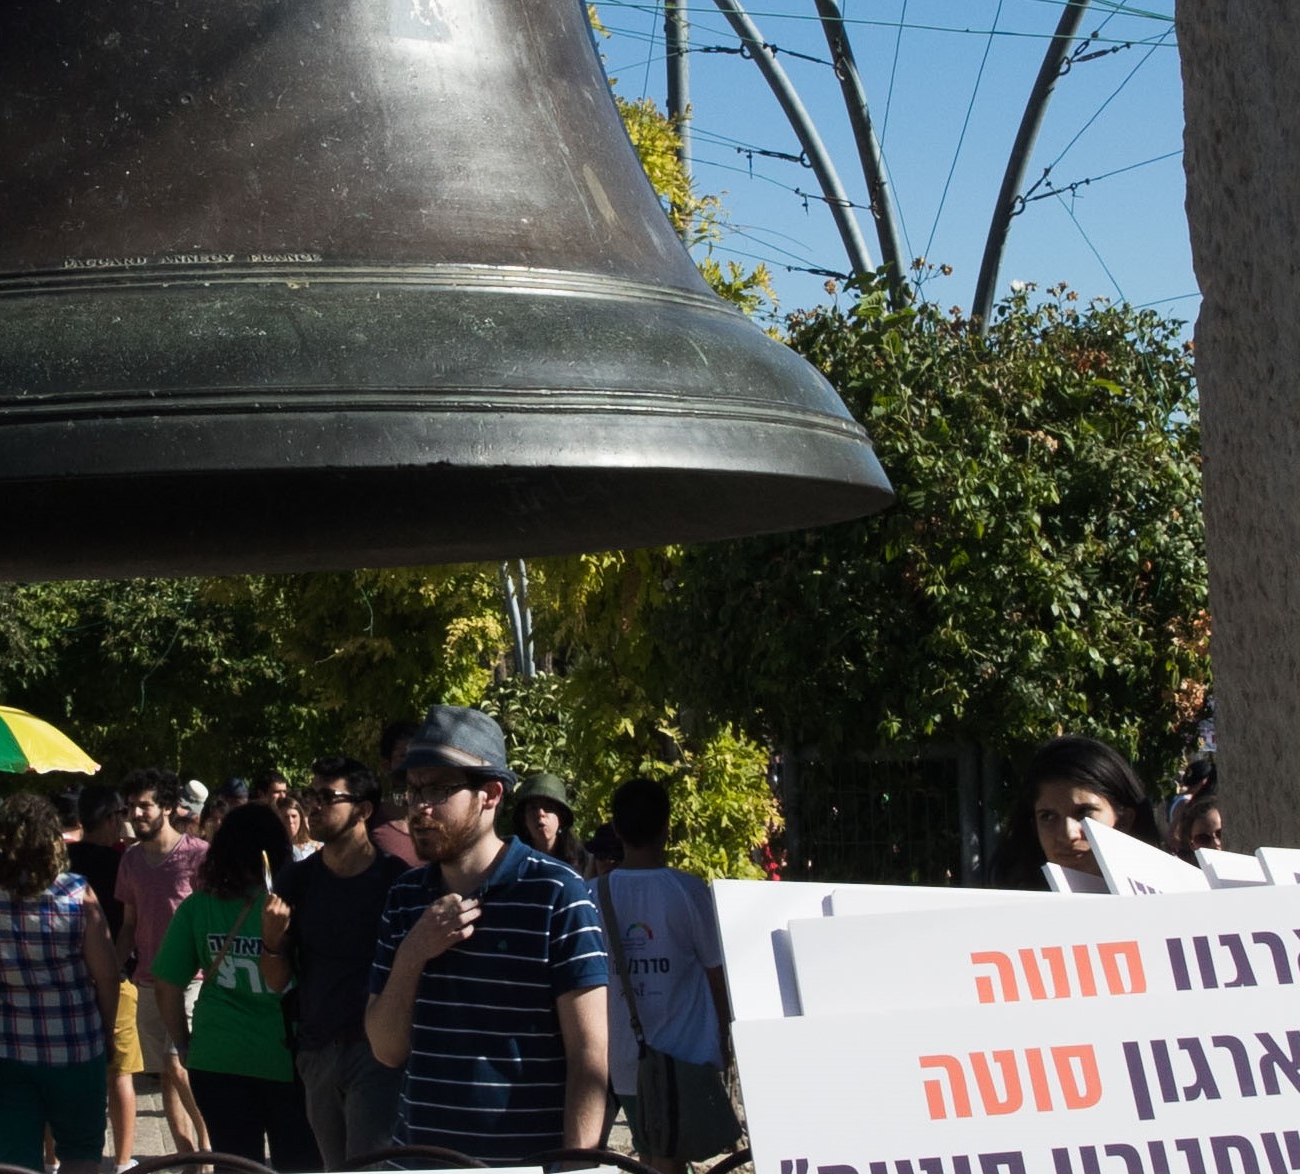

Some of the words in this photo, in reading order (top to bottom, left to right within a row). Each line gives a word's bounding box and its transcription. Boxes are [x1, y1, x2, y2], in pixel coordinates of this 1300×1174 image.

[248, 254, 322, 264] FRANCE
[970, 941, 1147, 1004] סוטה
[919, 1044, 1103, 1121] סוטה
